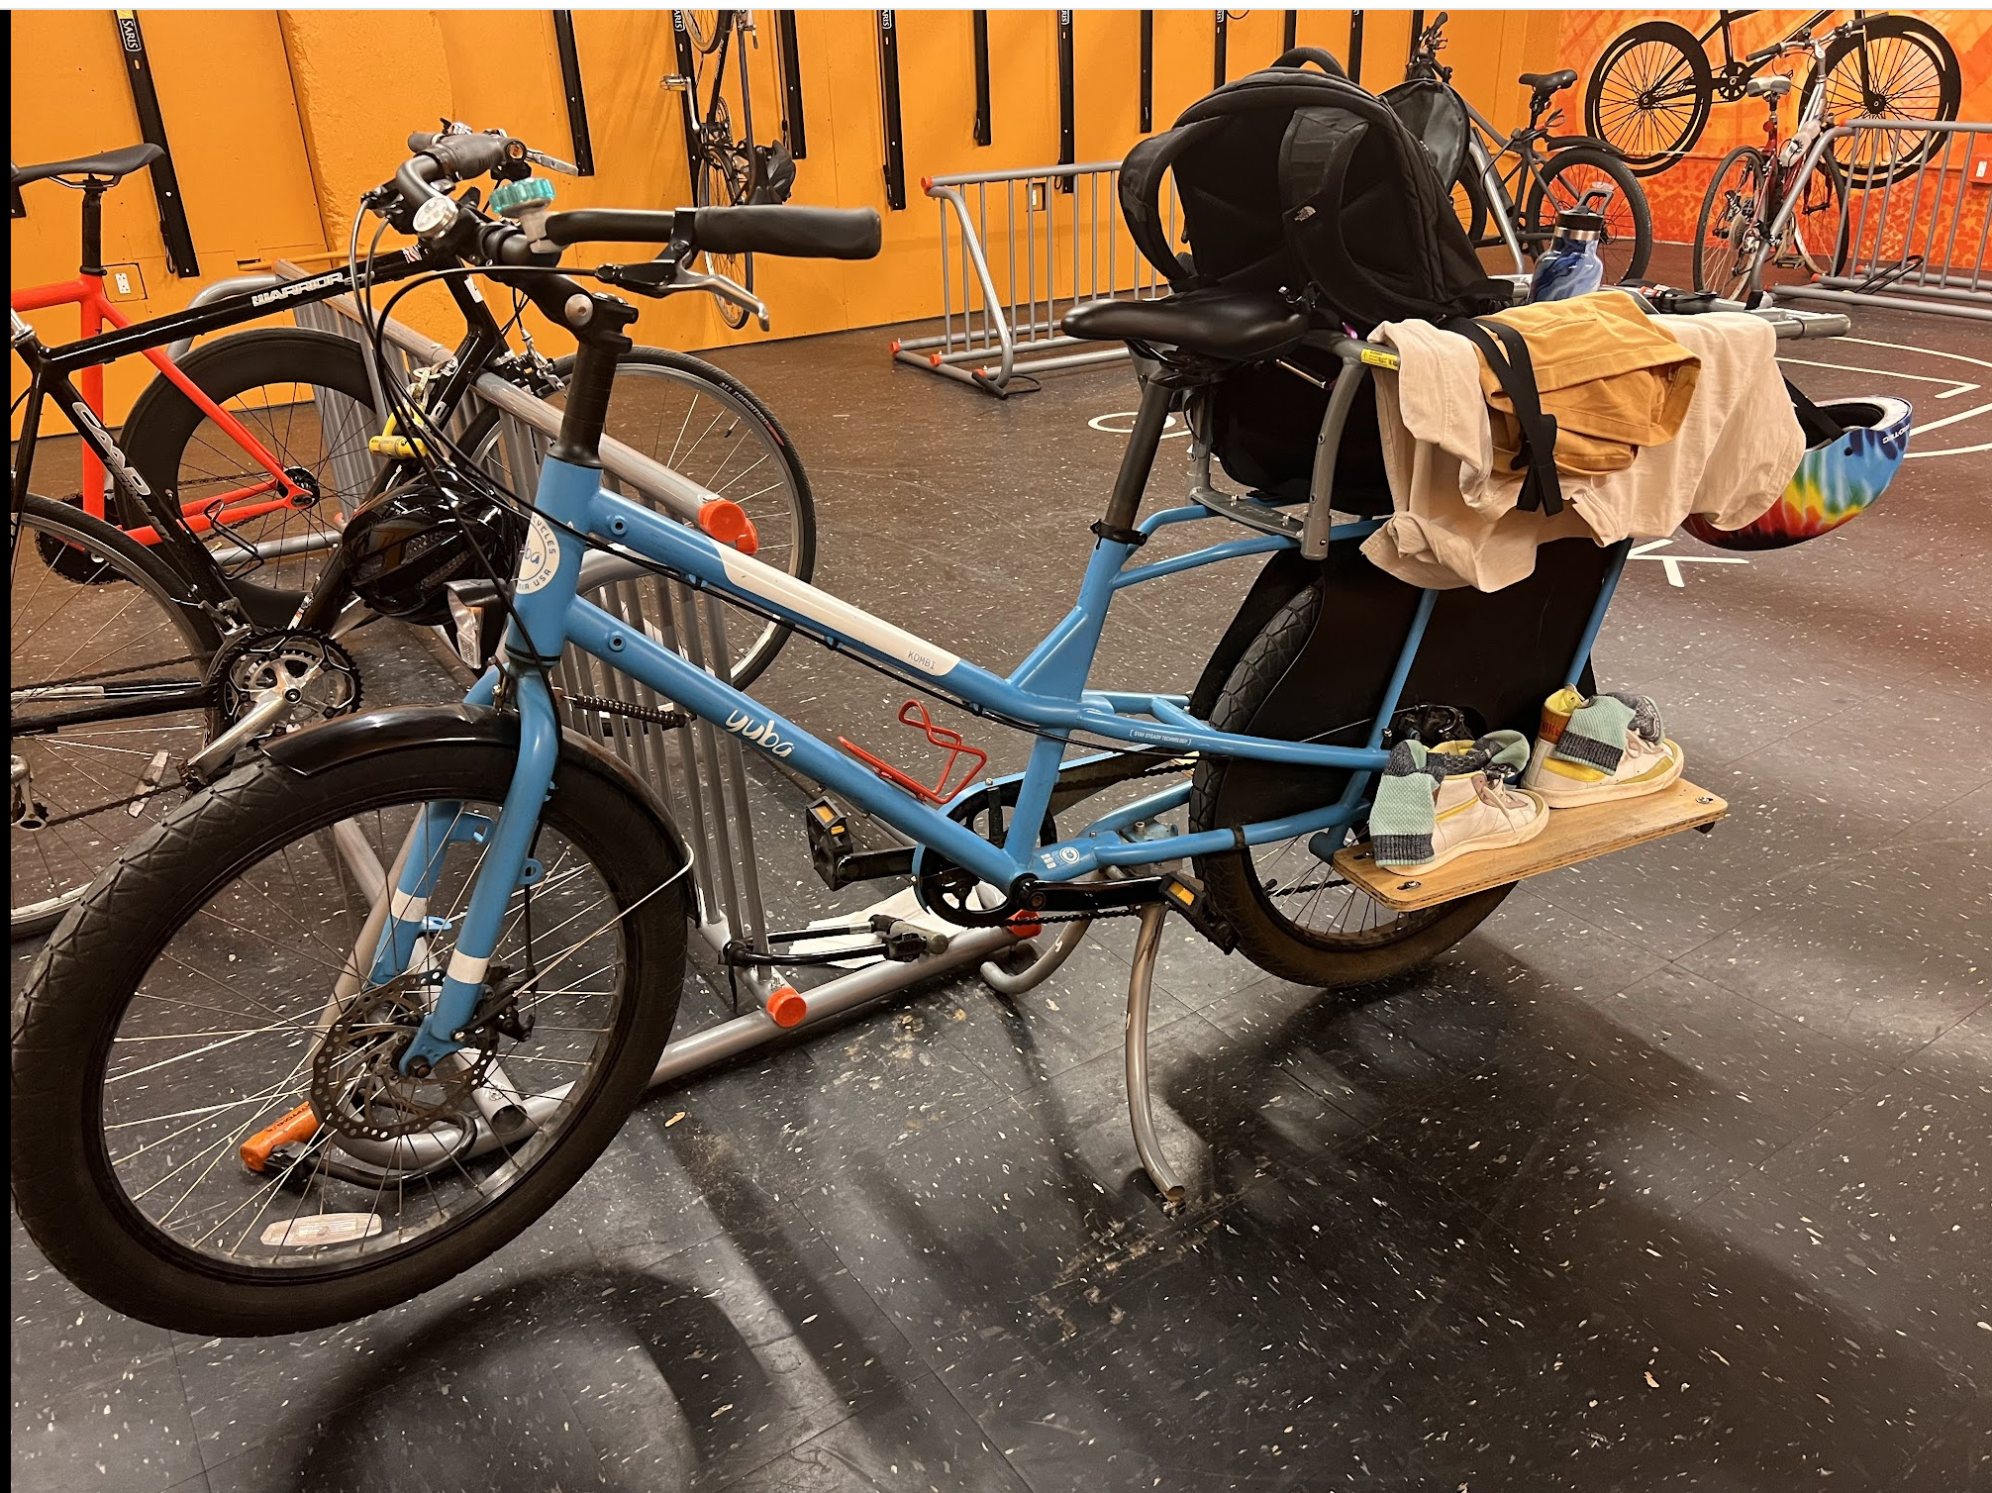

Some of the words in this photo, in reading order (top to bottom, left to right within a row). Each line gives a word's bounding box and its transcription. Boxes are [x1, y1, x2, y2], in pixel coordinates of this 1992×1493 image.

[122, 20, 139, 48] SARIS
[251, 272, 345, 307] WARRIOR
[72, 401, 151, 496] CAAD
[533, 568, 552, 587] USA
[907, 650, 936, 670] KOMBI
[725, 709, 796, 758] yuba
